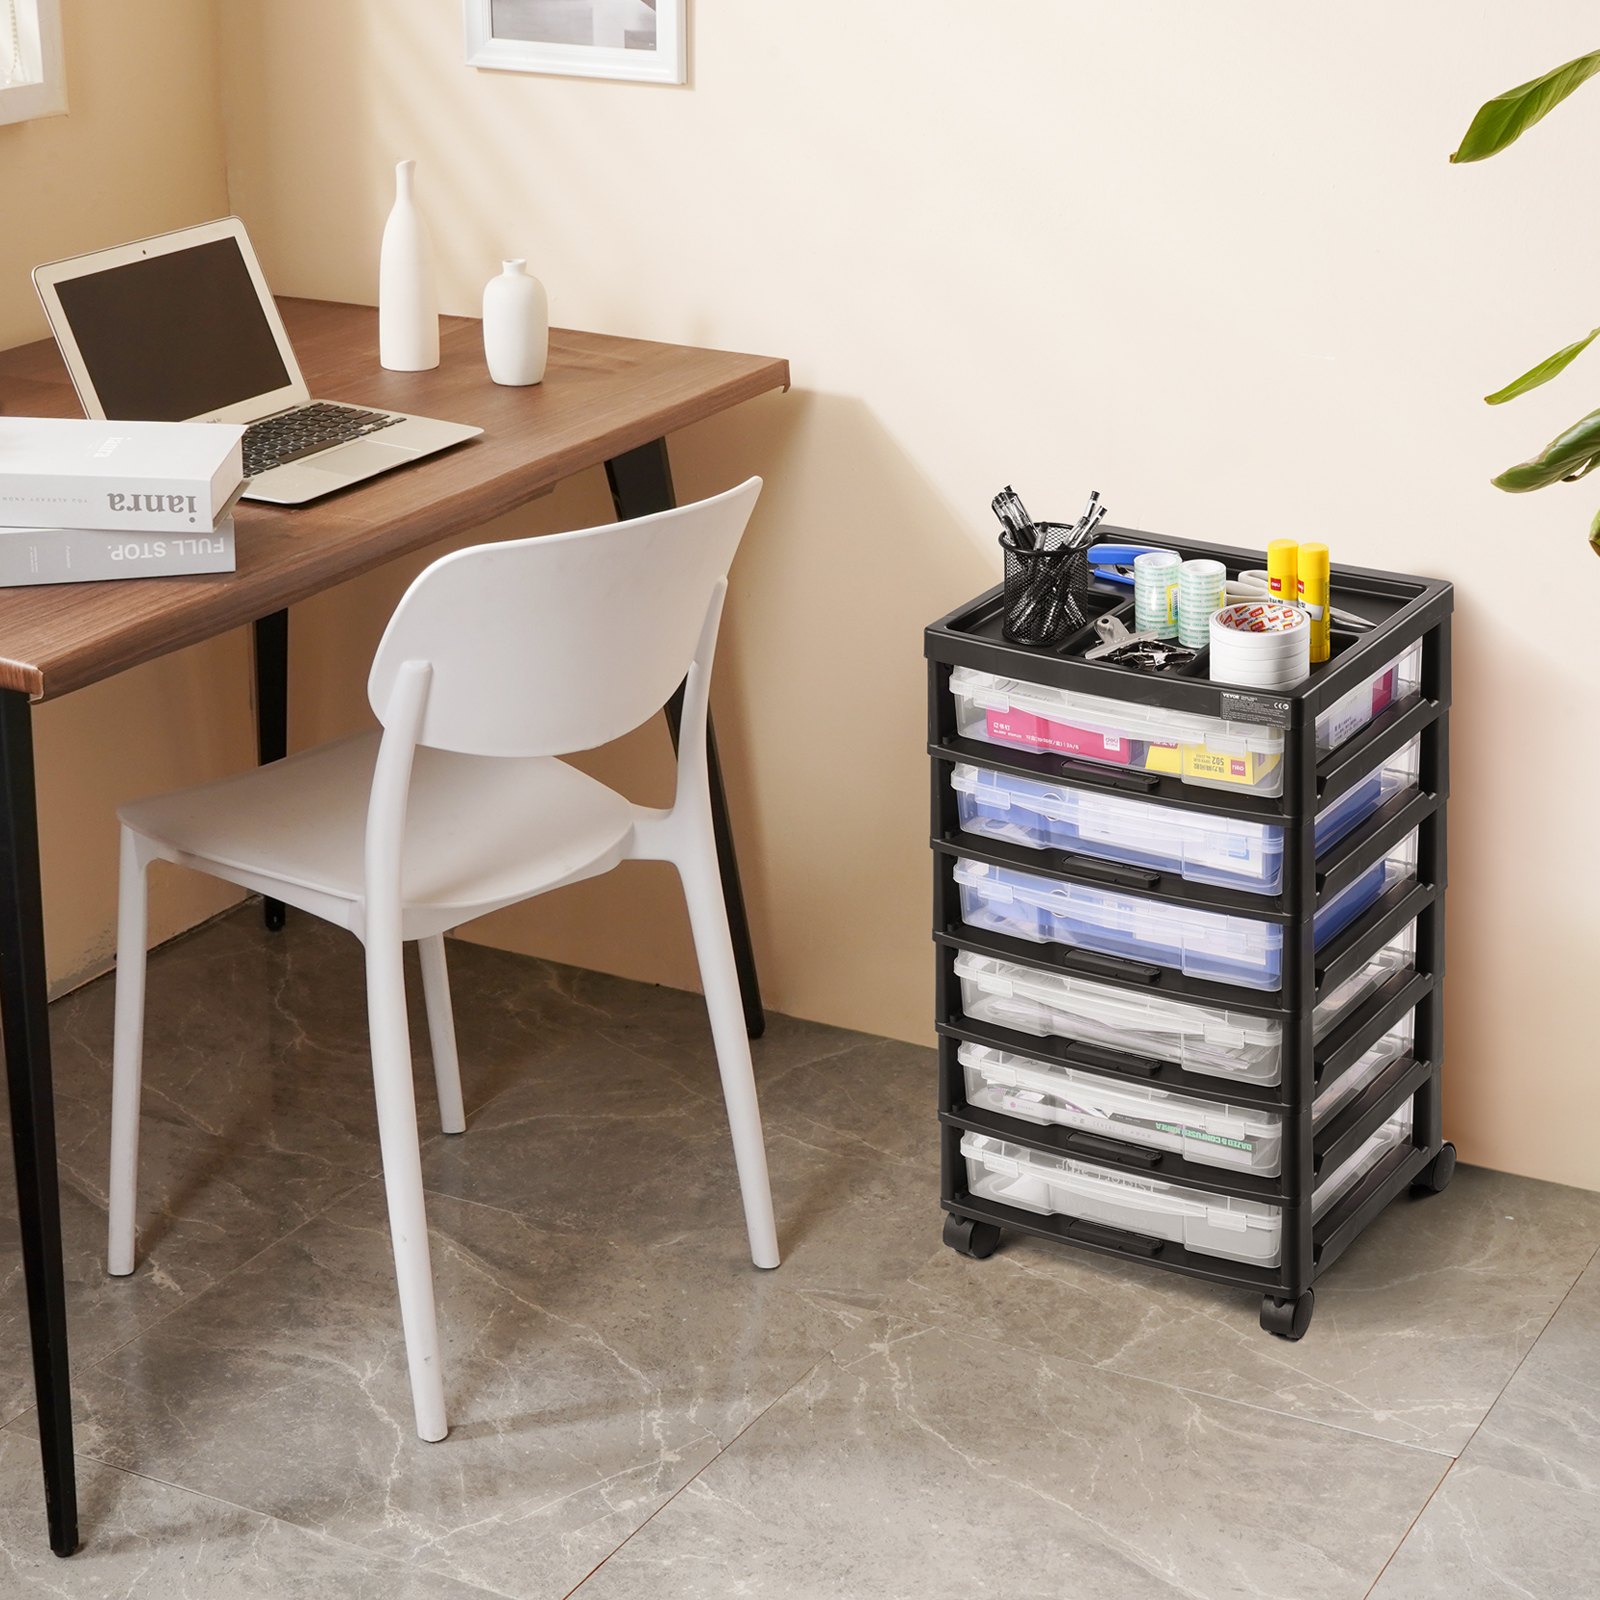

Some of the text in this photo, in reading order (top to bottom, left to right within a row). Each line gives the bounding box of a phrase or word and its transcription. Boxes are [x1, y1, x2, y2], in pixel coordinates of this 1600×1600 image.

[107, 492, 198, 523] ianra
[107, 537, 225, 560] FULL STOP.
[1222, 692, 1240, 700] VEVOR
[1211, 756, 1225, 766] 502
[1228, 1139, 1252, 1150] DAZED
